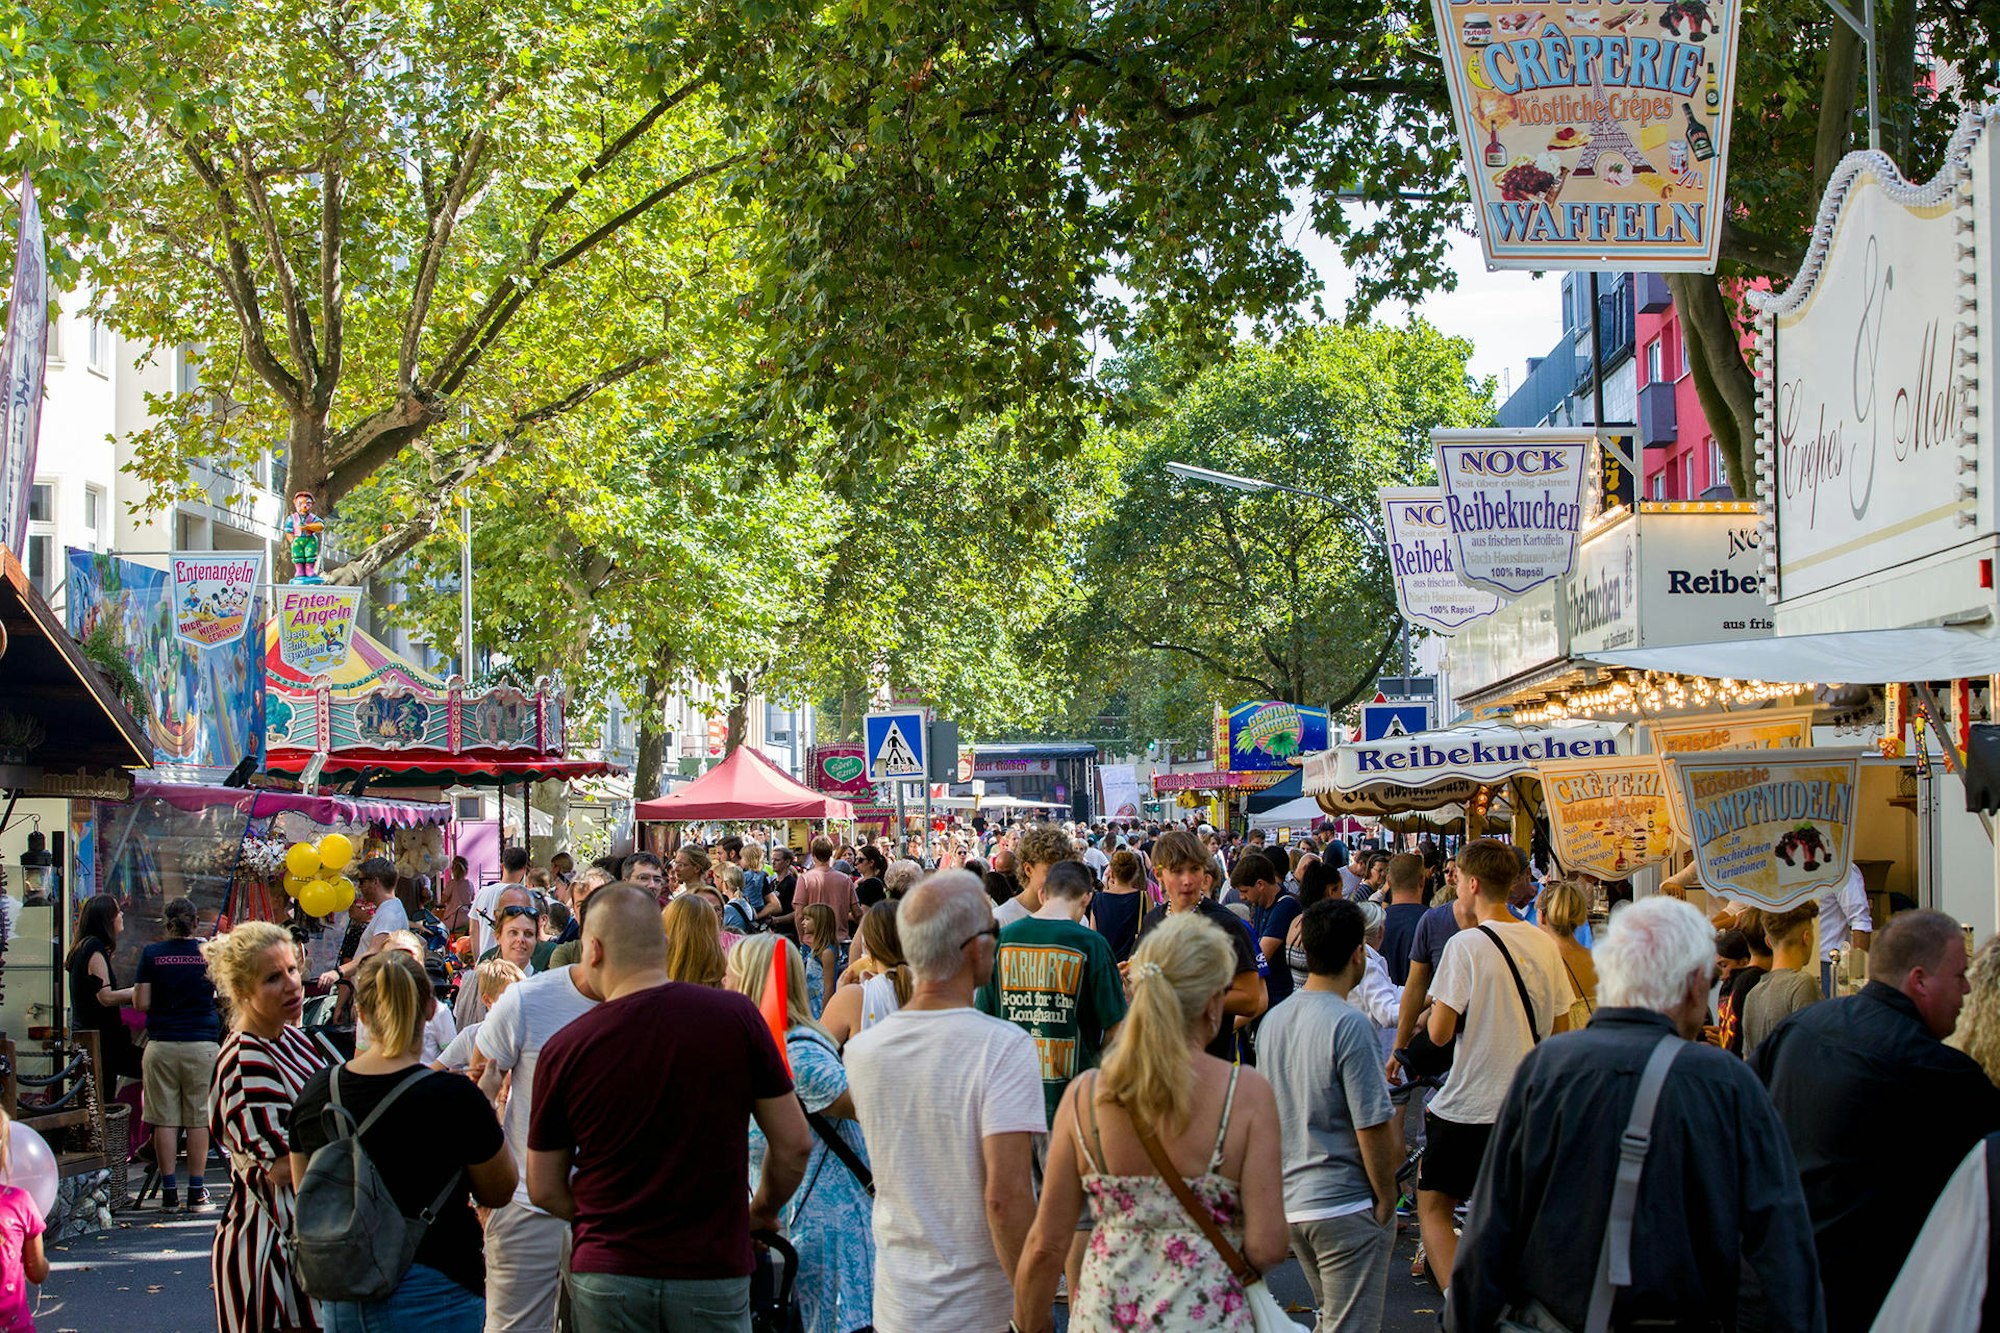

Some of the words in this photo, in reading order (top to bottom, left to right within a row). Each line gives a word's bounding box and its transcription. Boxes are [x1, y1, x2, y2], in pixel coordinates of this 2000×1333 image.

[1483, 22, 1705, 97] CRÊPERIE
[1517, 96, 1604, 126] Köstliche
[1487, 202, 1703, 242] WAFFELN
[1460, 449, 1567, 476] NOCK
[1456, 480, 1474, 488] Seit
[1477, 479, 1498, 488] über
[1501, 479, 1535, 489] dreißig
[1537, 478, 1570, 488] Jahren
[1445, 489, 1580, 534] Reibekuchen
[1471, 537, 1486, 547] aus
[1488, 534, 1521, 547] frischen
[1523, 533, 1564, 546] Kartoffeln
[175, 560, 254, 587] Entenangeln
[1413, 579, 1426, 587] aus
[1427, 578, 1456, 588] frischen
[1491, 567, 1513, 577] 100%
[1515, 567, 1544, 578] Rapsöl
[285, 593, 341, 611] Enten-
[1430, 606, 1449, 614] 100%
[1451, 605, 1475, 615] Rapsöl
[180, 619, 202, 634] HIER
[290, 604, 352, 627] Angeln
[1723, 621, 1746, 630] aus
[198, 622, 219, 636] WIRD
[286, 628, 309, 641] Jede
[286, 640, 307, 652] Ente
[1248, 703, 1297, 729] GEWINN
[1356, 737, 1618, 773] Reibekuchen
[1160, 777, 1198, 788] GOLDEN
[1200, 775, 1225, 786] GATE
[1692, 766, 1771, 799] Köstliche
[1562, 802, 1616, 824] Köstliche
[1693, 780, 1852, 848] DAMPFNUDELN
[1709, 841, 1771, 867] verschiedenen
[1716, 857, 1767, 881] Variationen
[1000, 951, 1081, 995] CARHARTT
[1002, 991, 1032, 1006] Good
[1034, 991, 1052, 1007] for
[1054, 992, 1075, 1009] the
[1008, 1006, 1068, 1025] Longhaul
